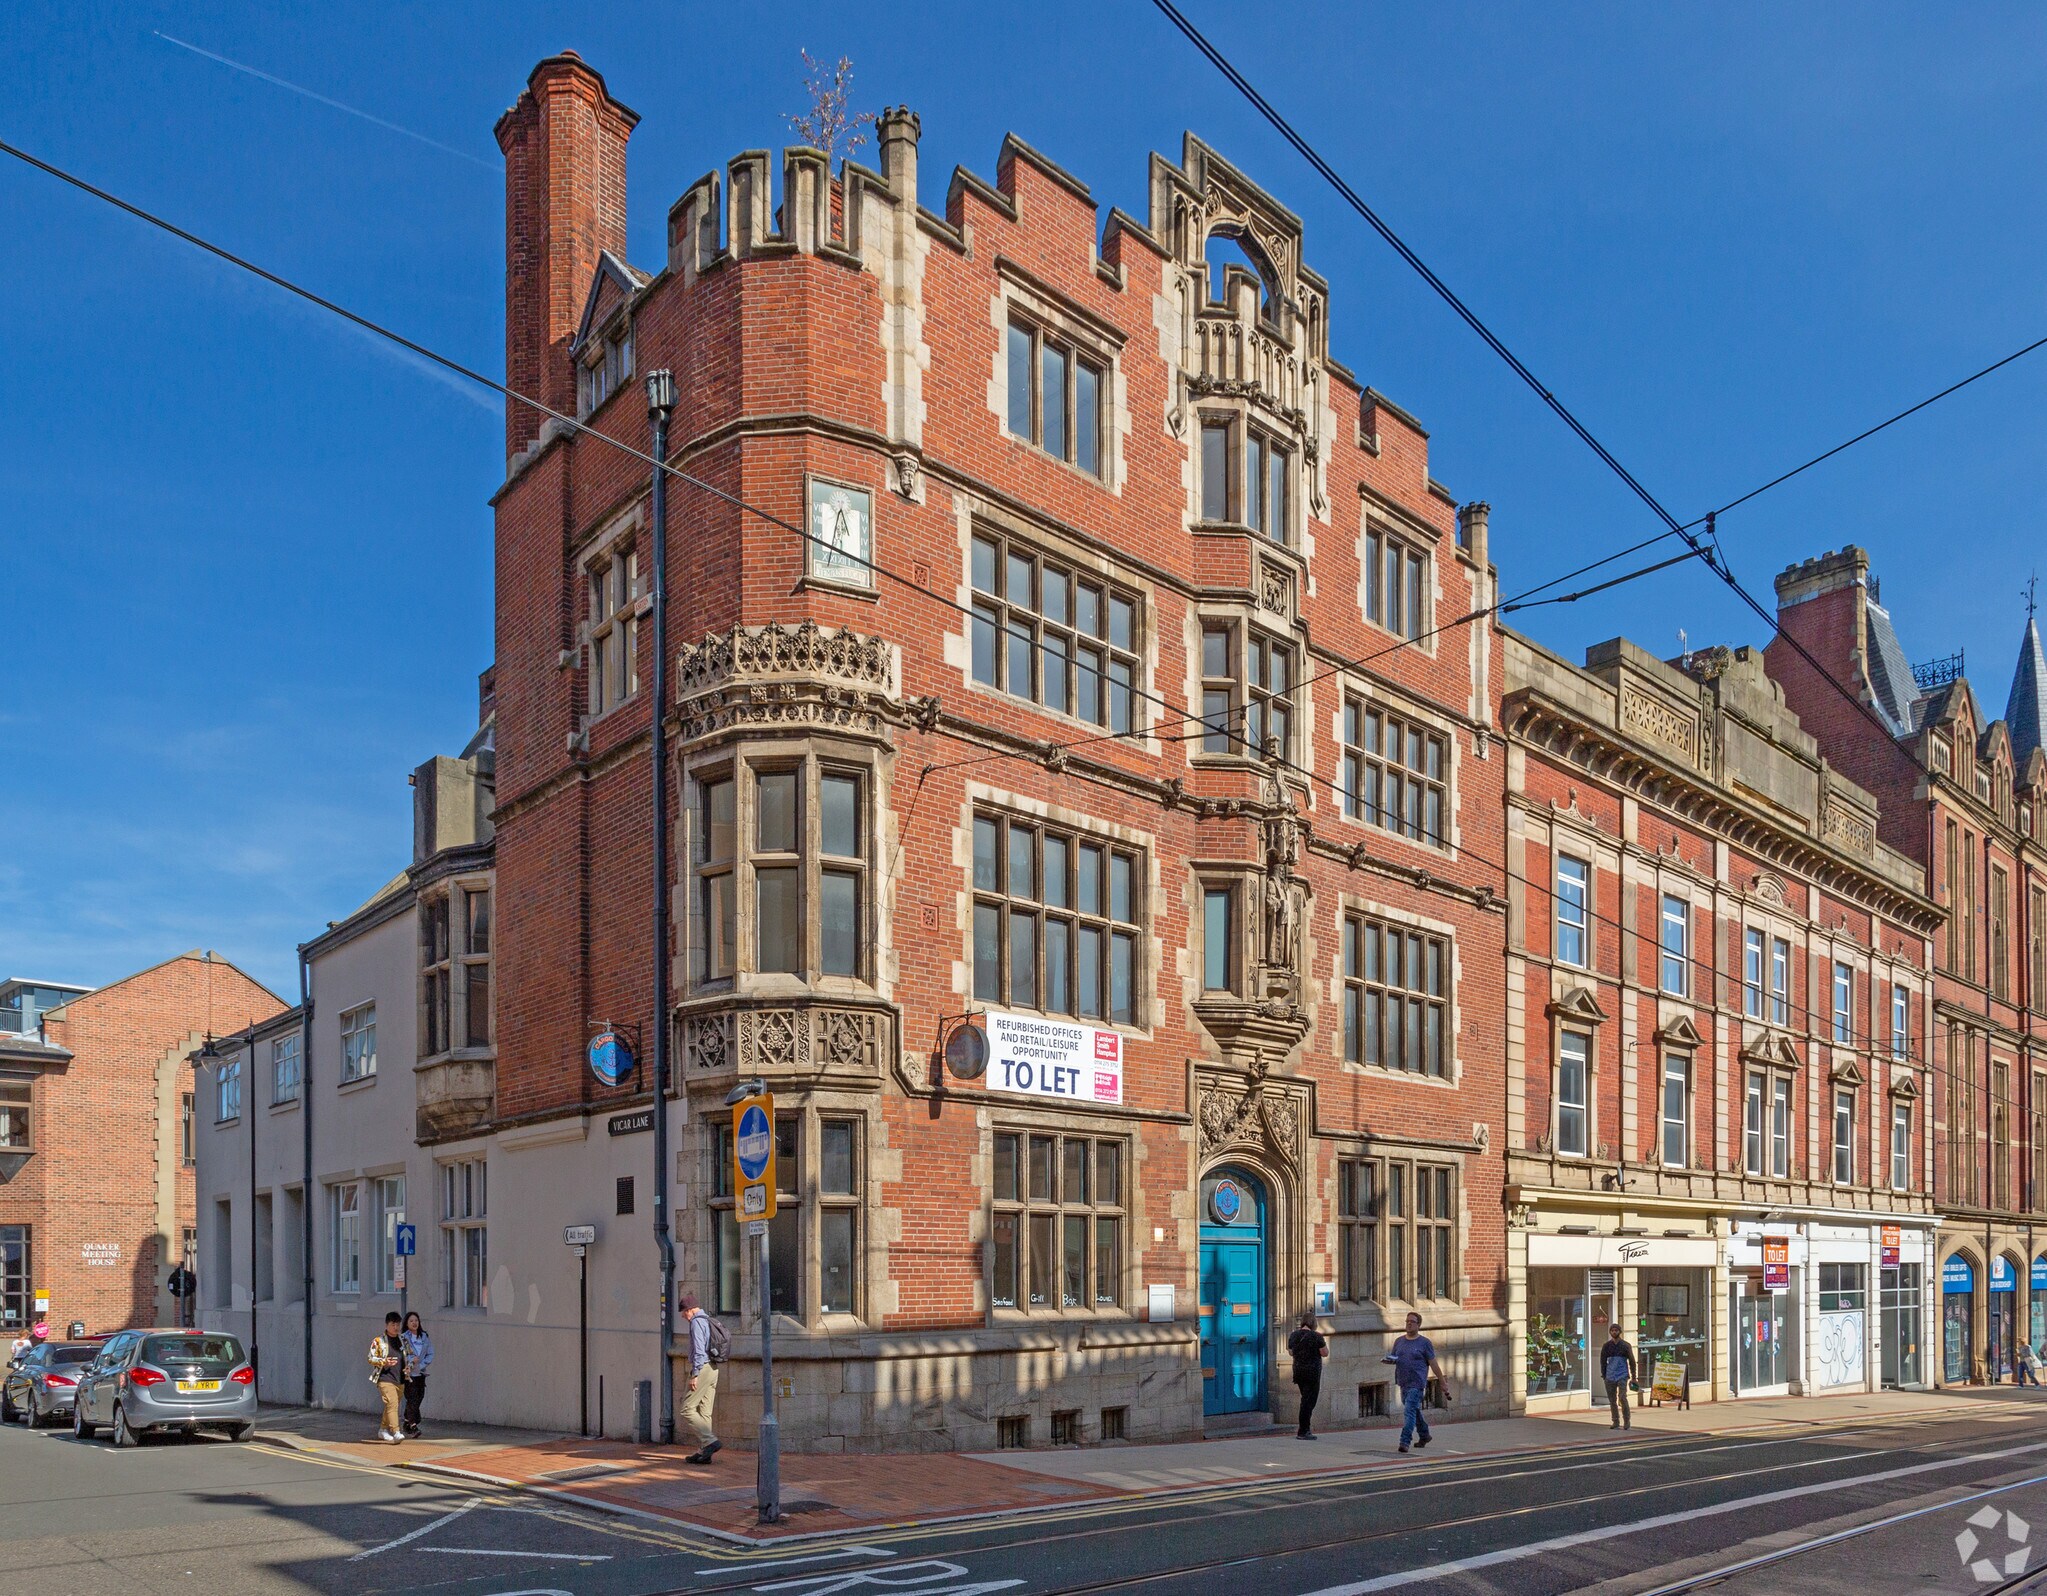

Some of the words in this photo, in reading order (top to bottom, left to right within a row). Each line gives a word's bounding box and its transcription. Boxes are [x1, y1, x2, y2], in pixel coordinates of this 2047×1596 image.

[996, 1019, 1050, 1035] REFURBISHED
[1052, 1026, 1082, 1040] OFFICES
[594, 1036, 614, 1050] CARGO
[1000, 1032, 1018, 1043] AND
[1020, 1034, 1078, 1051] RETAIL/LEISURE
[1096, 1034, 1115, 1044] Lambert
[1096, 1042, 1110, 1050] Smith
[1012, 1046, 1068, 1061] OPPORTUNITY
[1096, 1048, 1116, 1058] Hampton
[1000, 1059, 1033, 1090] TO
[1040, 1064, 1080, 1094] LET
[613, 1119, 631, 1131] VICAR
[632, 1116, 649, 1128] LANE
[746, 1193, 762, 1206] Only
[578, 1230, 593, 1241] traffic
[1767, 1250, 1776, 1261] TO
[1776, 1250, 1786, 1261] LET
[992, 1297, 1014, 1306] Seafood
